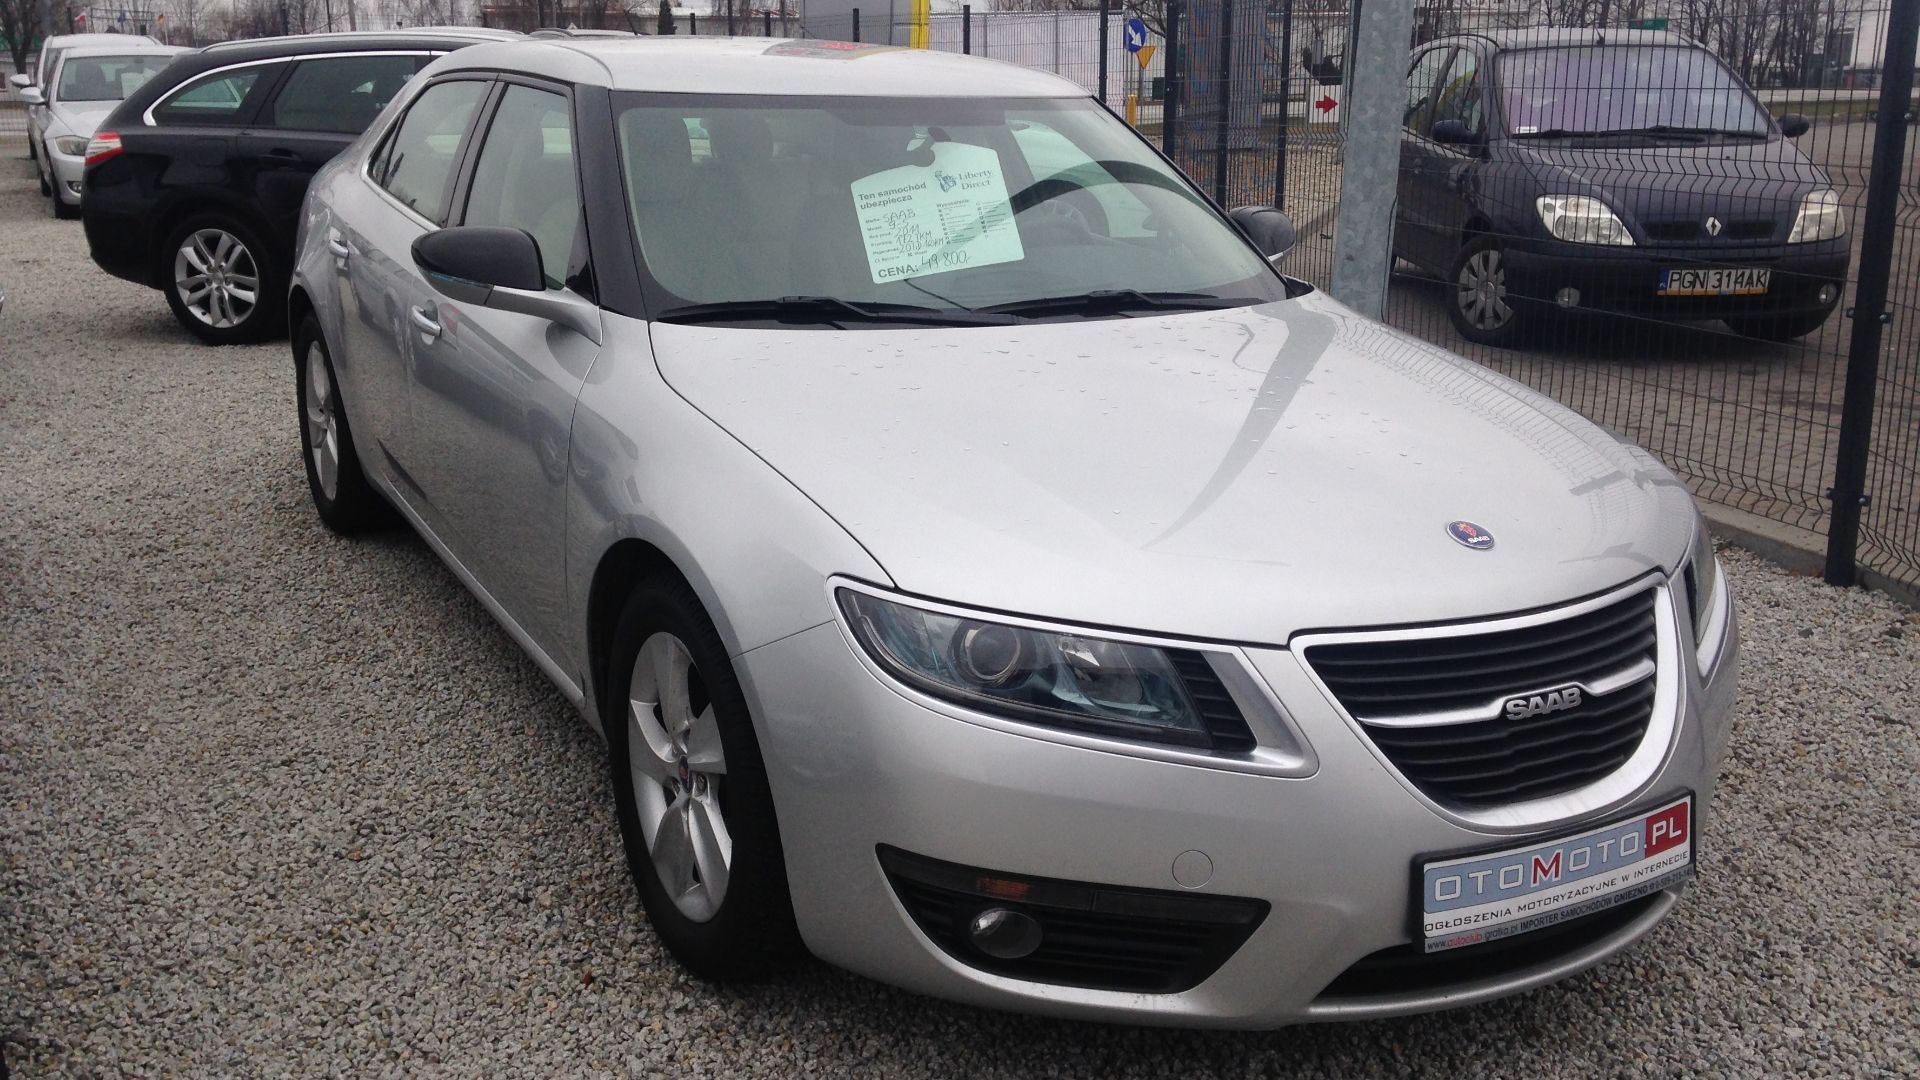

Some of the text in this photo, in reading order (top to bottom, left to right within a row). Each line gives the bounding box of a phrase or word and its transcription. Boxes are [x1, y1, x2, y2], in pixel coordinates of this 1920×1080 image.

[958, 169, 993, 182] Liberty
[858, 182, 927, 201] Ten samochód
[961, 181, 992, 191] Direct
[860, 194, 913, 210] ubezpiecza
[883, 208, 916, 223] SAAB
[878, 264, 919, 278] CENA:
[1669, 269, 1767, 289] PGN 314AK
[1468, 535, 1490, 544] SAAB
[1506, 687, 1582, 720] SAAB
[1424, 850, 1689, 932] OGŁOSZENIA MOTORYZACYJNE W INTERNECIE
[1520, 914, 1559, 933] IMPORTER
[1560, 897, 1613, 920] SAMOCHODÓW
[1613, 884, 1648, 905] GNIEZNO
